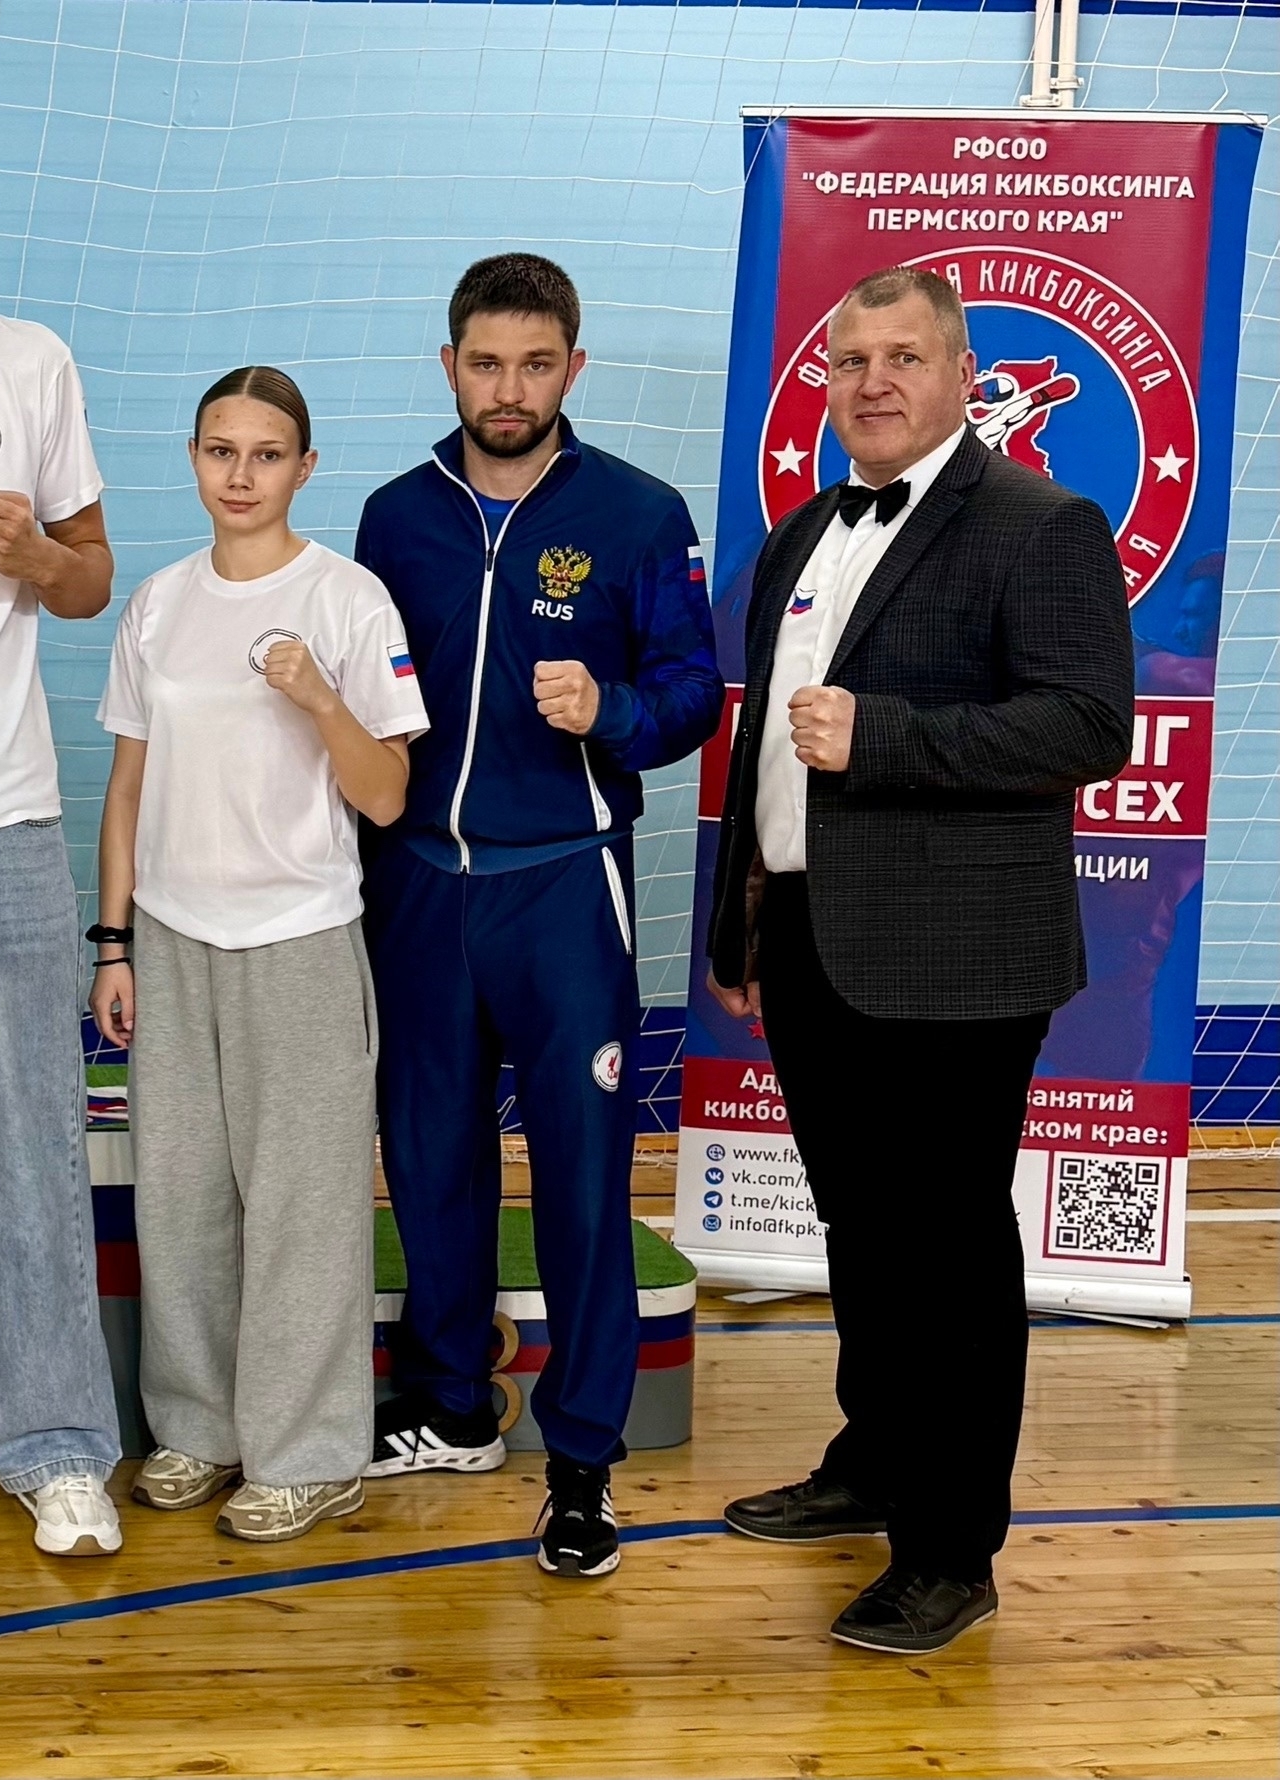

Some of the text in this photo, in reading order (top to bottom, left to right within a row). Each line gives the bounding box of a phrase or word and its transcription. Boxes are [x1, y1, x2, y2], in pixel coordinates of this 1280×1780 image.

[952, 137, 1048, 161] РФСОО
[801, 171, 1195, 200] "ФЕДЕРАЦИЯ КИКБОКСИНГА
[866, 207, 1123, 234] ПЕРМСКОГО КРАЯ"
[979, 258, 1173, 393] КИКБОКСИНГА
[531, 598, 575, 621] RUS
[1075, 779, 1185, 823] СЕХ
[704, 1099, 787, 1122] кикбо
[1027, 1088, 1135, 1112] анятий
[1091, 1123, 1168, 1148] крае:
[732, 1148, 805, 1167] www.fk
[730, 1193, 816, 1212] t.me/kick
